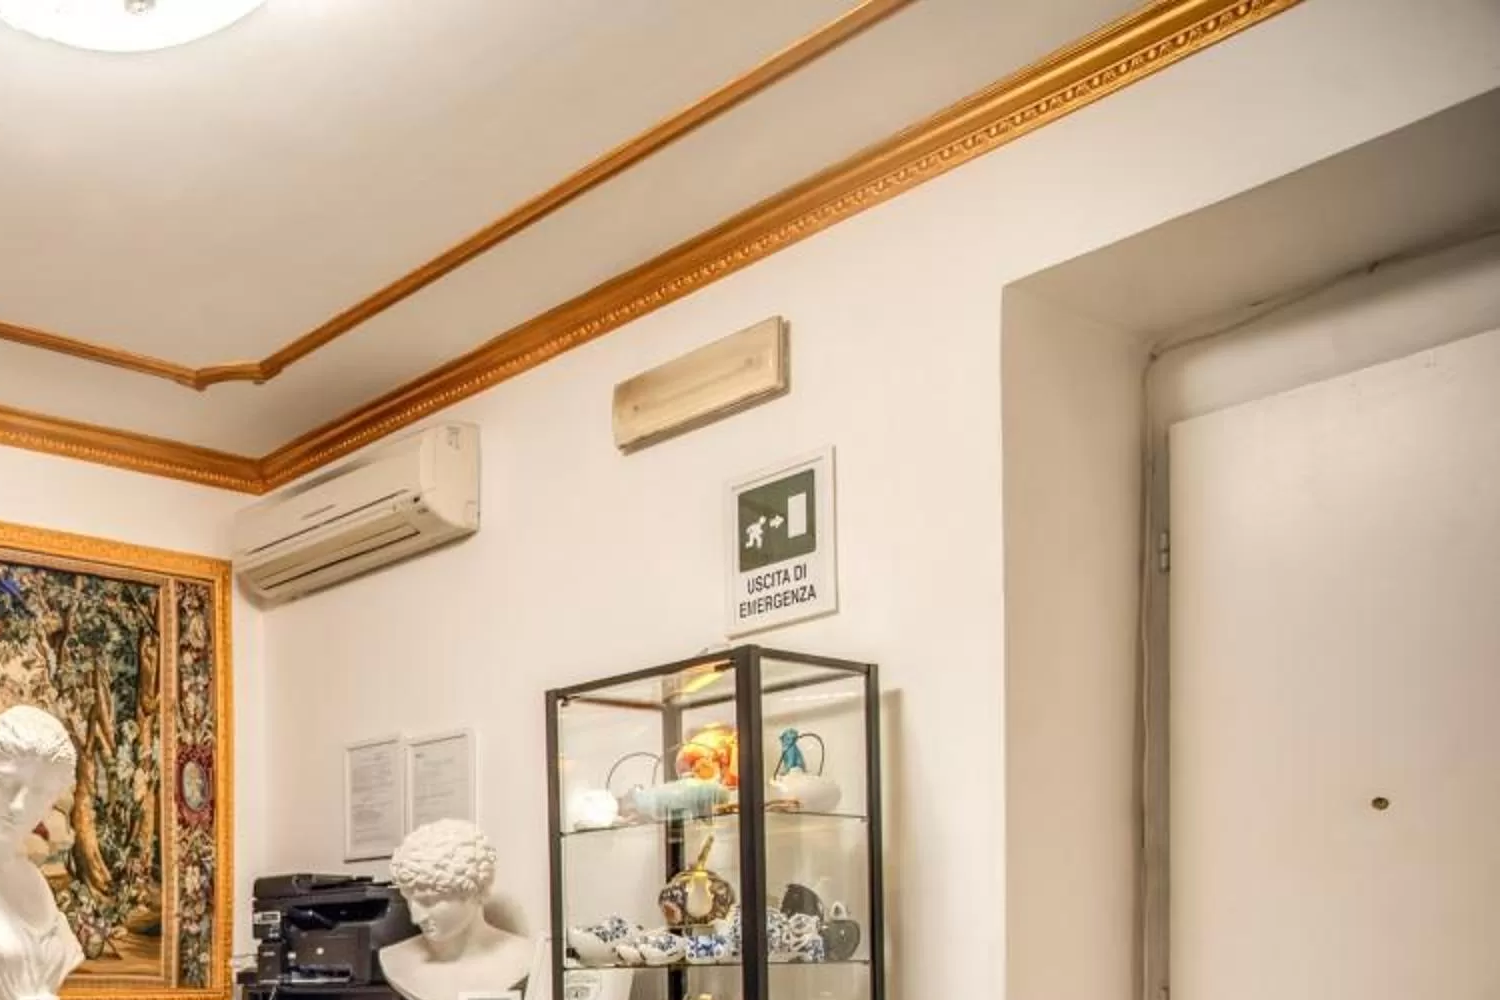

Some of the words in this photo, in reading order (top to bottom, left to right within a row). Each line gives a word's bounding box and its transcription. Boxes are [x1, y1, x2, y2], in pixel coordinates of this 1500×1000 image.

[747, 569, 791, 594] USCITA
[794, 564, 807, 581] DI
[739, 585, 817, 618] EMERGENZA
